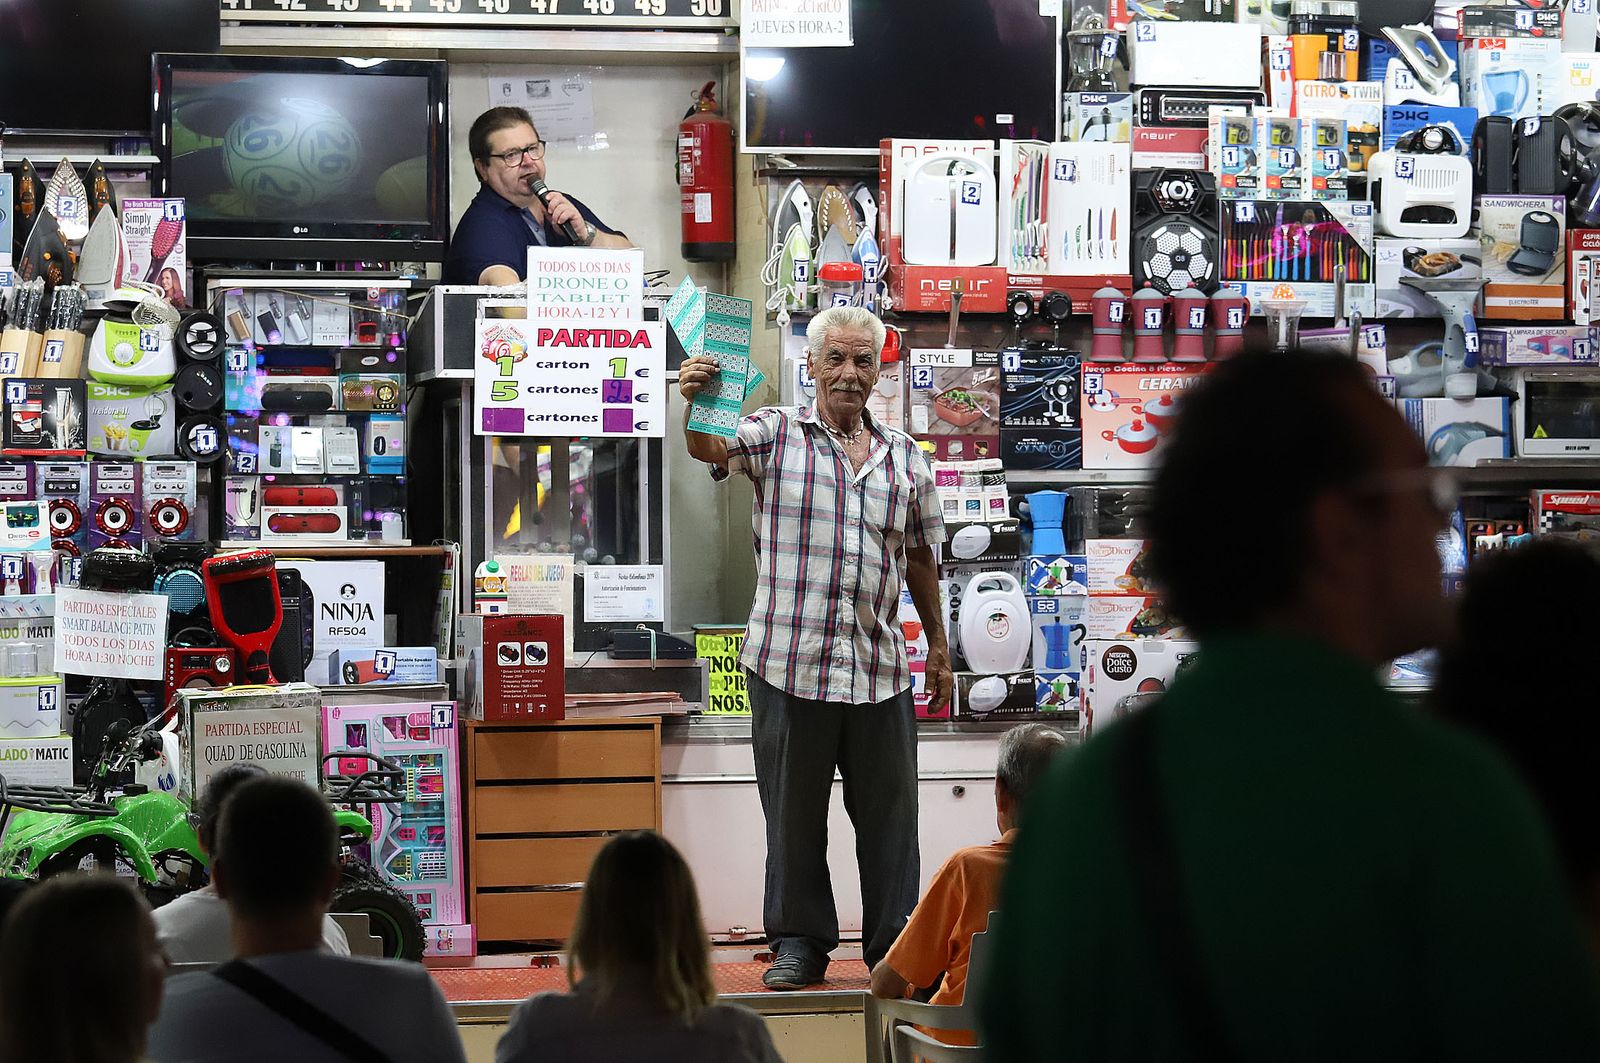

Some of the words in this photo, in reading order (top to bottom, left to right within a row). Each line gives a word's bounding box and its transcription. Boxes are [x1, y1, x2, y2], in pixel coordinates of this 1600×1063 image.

[751, 20, 795, 34] JUEVES
[798, 20, 844, 34] HORA-2
[1304, 85, 1336, 97] CITRO
[1352, 86, 1380, 98] TWIN
[1392, 111, 1429, 120] DHG
[125, 213, 152, 225] Simply
[126, 225, 151, 237] Straight
[538, 261, 576, 273] TODOS
[580, 262, 601, 273] LOS
[604, 262, 631, 273] DIAS
[538, 277, 608, 290] DRONE
[615, 278, 628, 290] O
[537, 294, 630, 303] TABLET
[538, 307, 604, 318] HORA-12
[609, 307, 620, 318] Y
[537, 328, 652, 348] PARTIDA
[919, 354, 955, 363] STYLE
[496, 356, 514, 376] 1
[536, 360, 590, 369] carton
[609, 357, 627, 378] 1
[635, 368, 649, 378] €
[1138, 376, 1201, 390] CERAM
[94, 387, 130, 396] DHG
[491, 381, 519, 401] 5
[527, 386, 598, 394] cartones
[607, 380, 631, 403] 2
[635, 393, 649, 403] €
[527, 413, 598, 422] cartones
[635, 421, 649, 431] €
[1112, 546, 1132, 554] Dicer
[511, 565, 533, 581] REGLAS
[545, 565, 565, 581] JUEGO
[63, 601, 104, 615] PARTIDAS
[106, 602, 157, 618] ESPECIALES
[321, 603, 375, 623] NINJA
[27, 626, 54, 638] MATI
[62, 617, 89, 631] SMART
[90, 618, 131, 634] BALANCE
[133, 621, 156, 635] PATIN
[329, 626, 366, 636] RF504
[64, 634, 99, 648] TODOS
[102, 637, 125, 649] LOS
[128, 639, 155, 651] DIAS
[65, 651, 93, 662] HORA
[95, 653, 115, 664] 1:30
[119, 654, 155, 666] NOCHE
[1107, 658, 1132, 666] Dolce
[205, 722, 251, 737] PARTIDA
[253, 720, 303, 735] ESPECIAL
[36, 748, 68, 760] MATIC
[205, 745, 235, 766] QUAD
[240, 744, 253, 760] DE
[255, 742, 307, 760] GASOLINA
